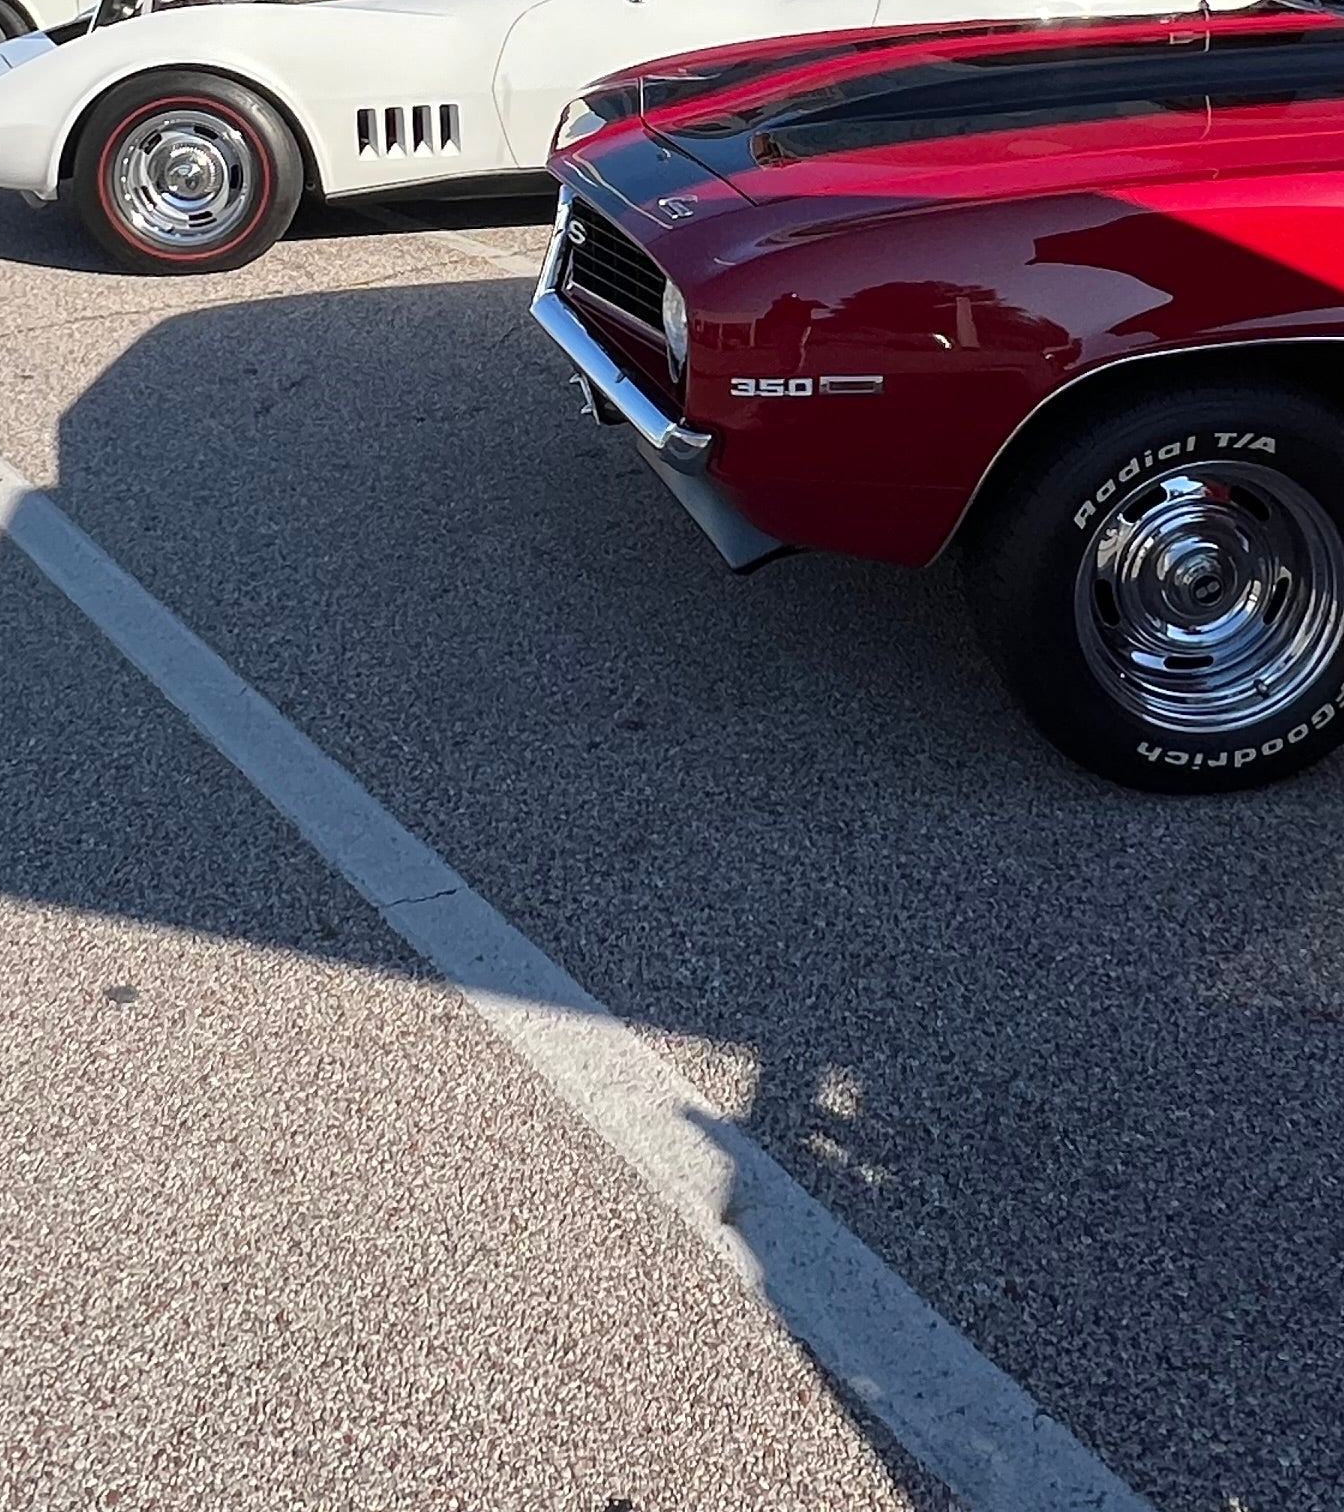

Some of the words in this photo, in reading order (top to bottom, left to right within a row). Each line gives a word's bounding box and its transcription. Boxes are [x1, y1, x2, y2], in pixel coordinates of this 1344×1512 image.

[730, 377, 813, 397] 350
[1073, 436, 1197, 530] Radial
[1213, 432, 1277, 455] T/A
